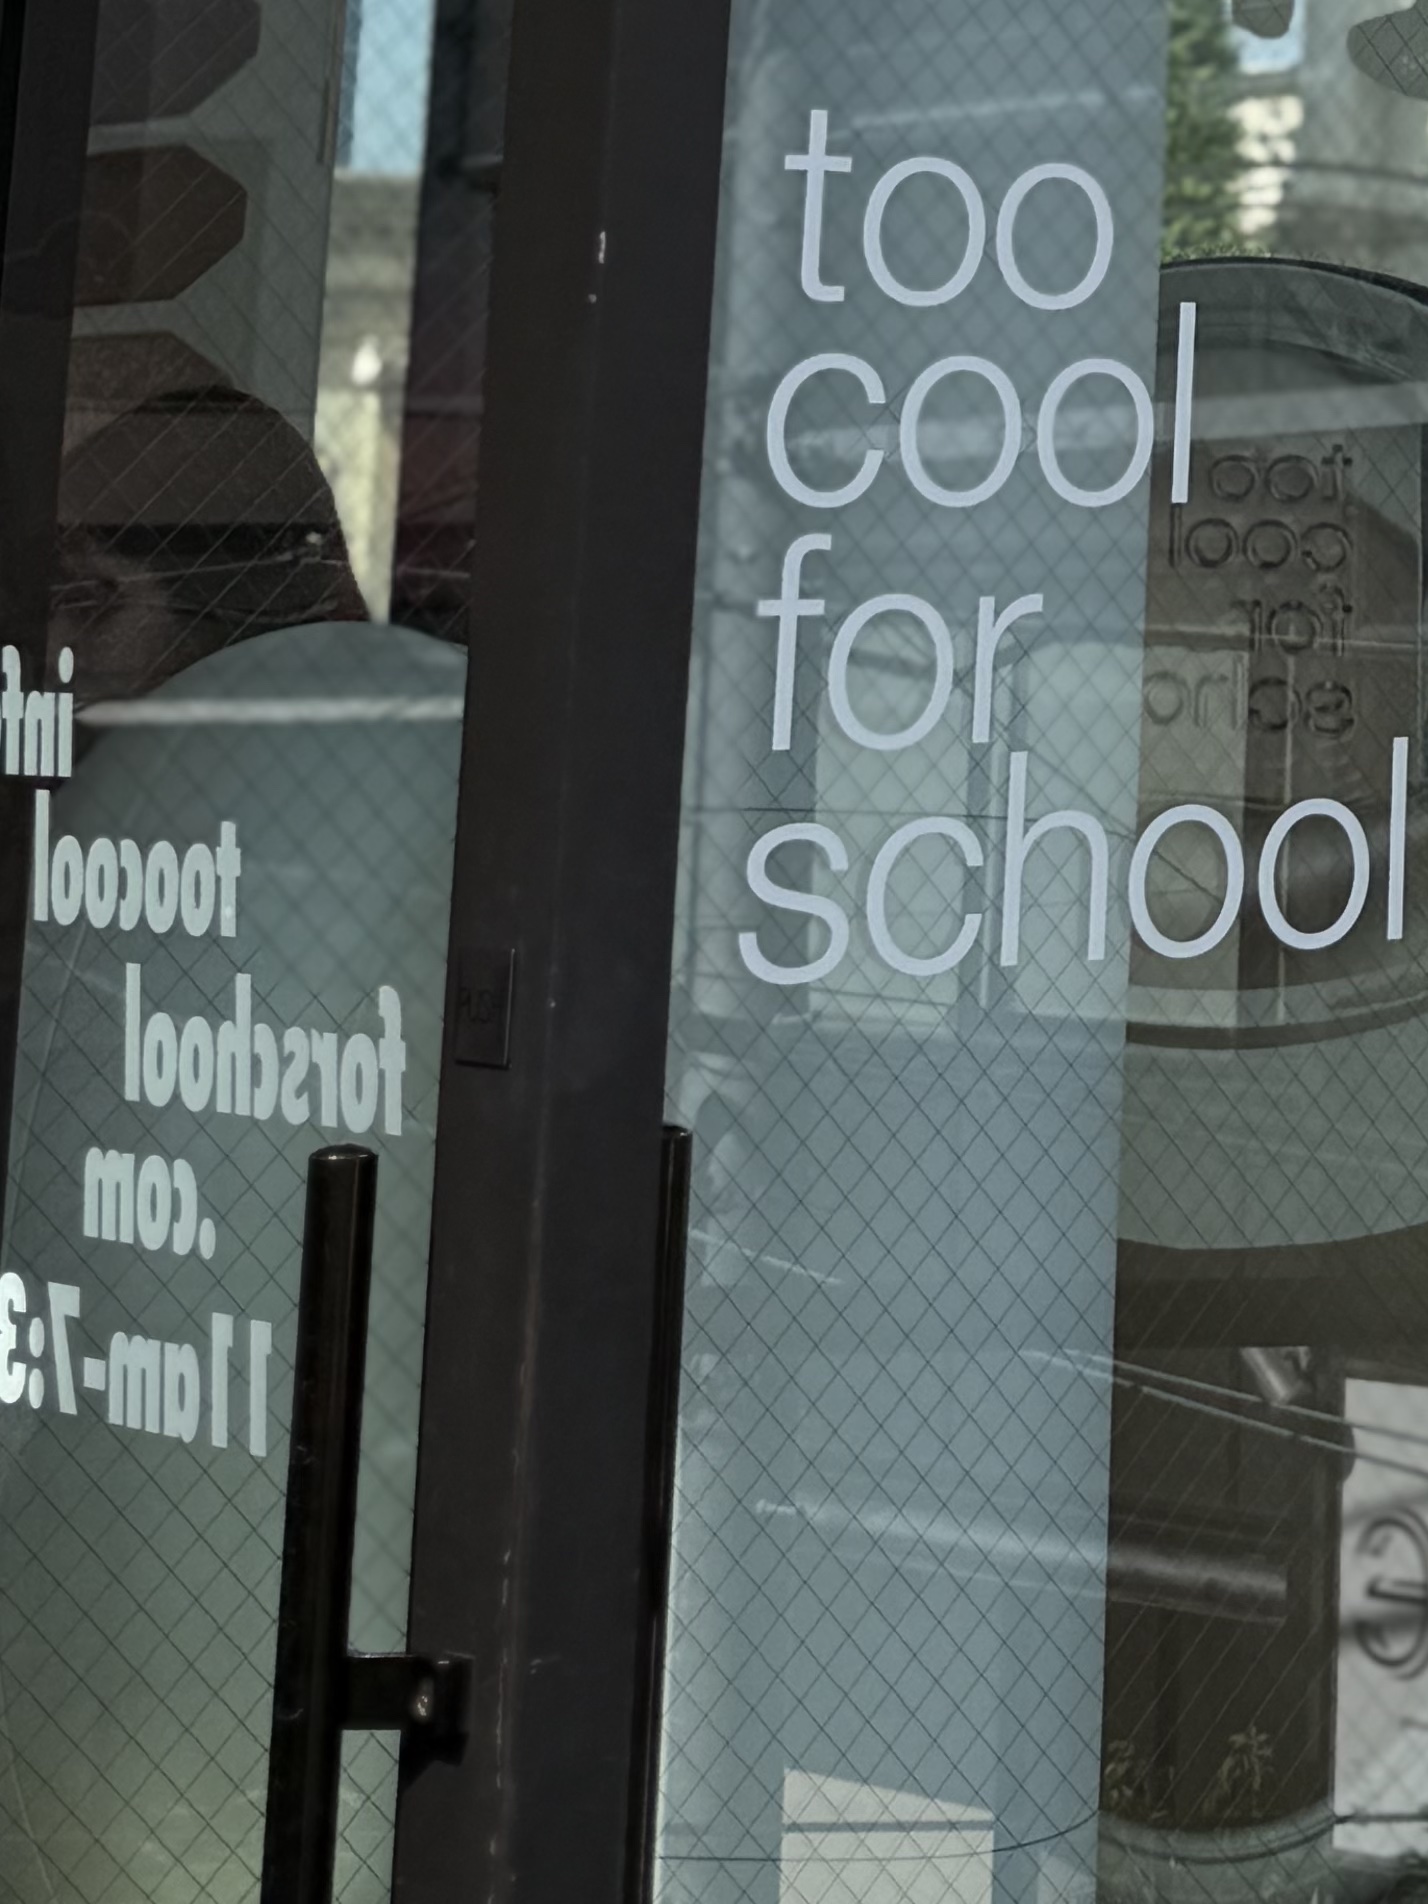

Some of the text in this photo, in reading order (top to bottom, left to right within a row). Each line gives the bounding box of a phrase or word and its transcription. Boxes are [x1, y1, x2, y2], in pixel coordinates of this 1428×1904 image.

[784, 109, 1114, 310] too
[766, 302, 1196, 508] cool
[756, 533, 1044, 752] for
[738, 736, 1410, 986] school
